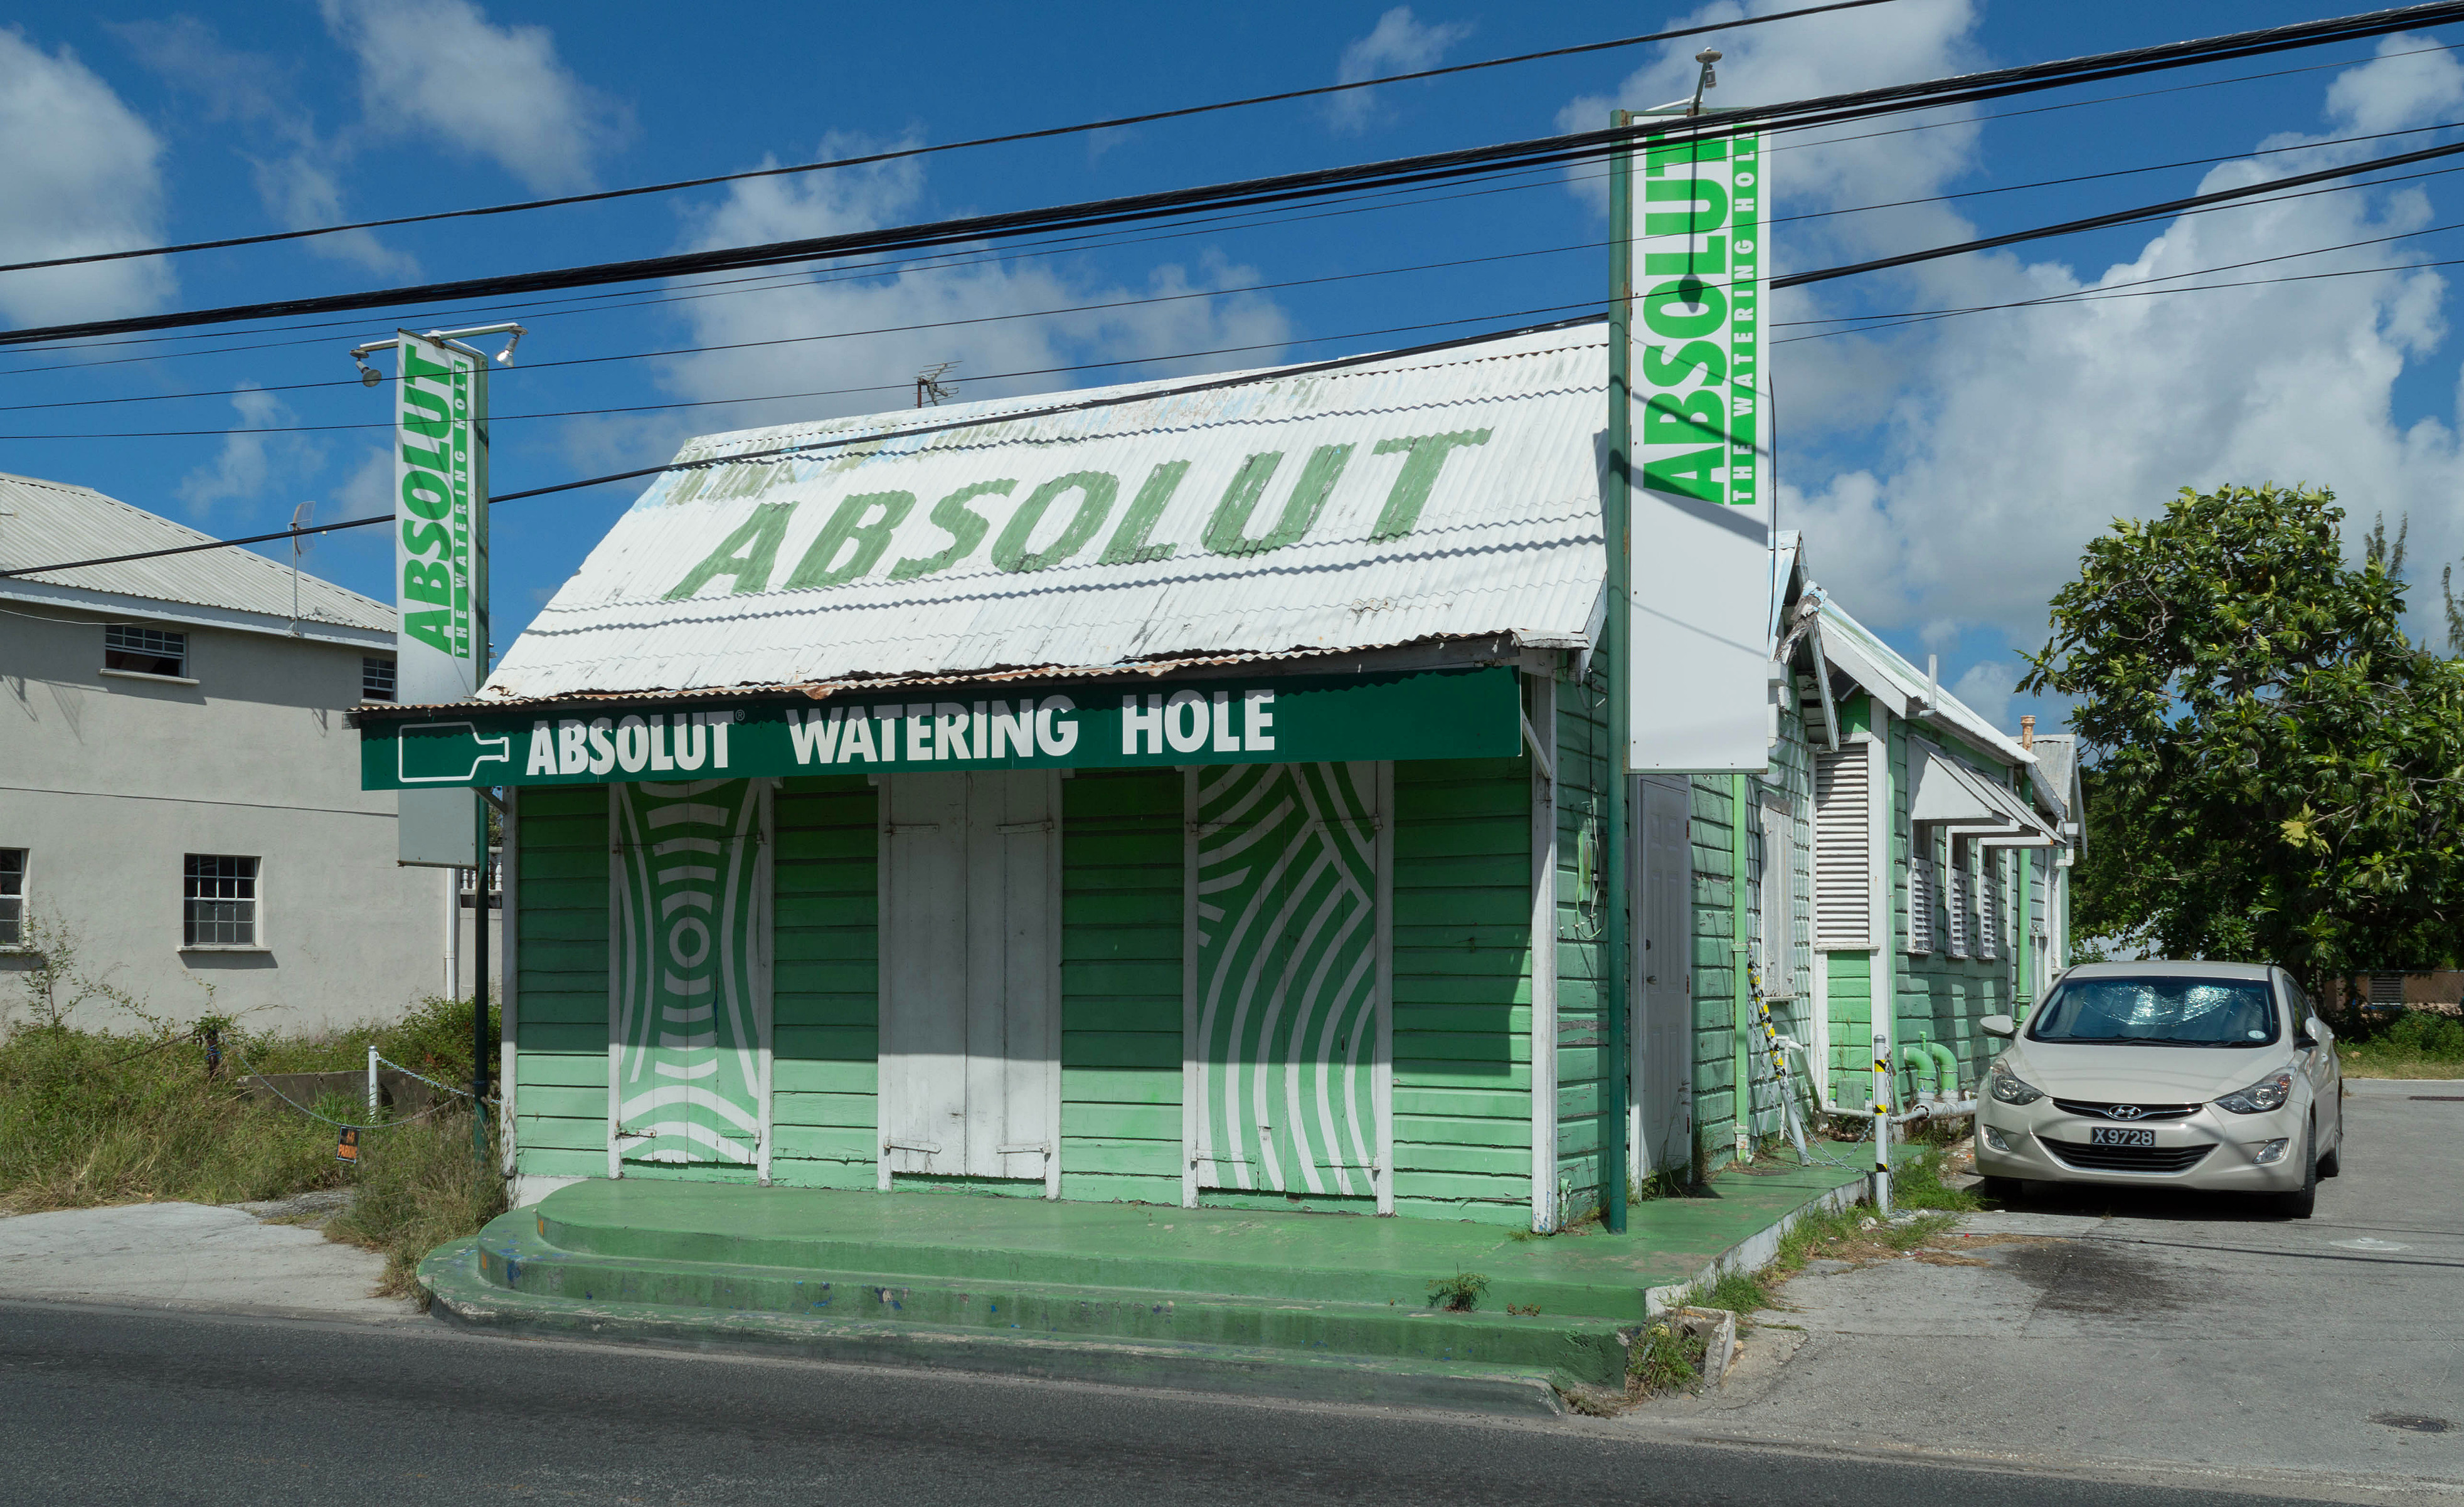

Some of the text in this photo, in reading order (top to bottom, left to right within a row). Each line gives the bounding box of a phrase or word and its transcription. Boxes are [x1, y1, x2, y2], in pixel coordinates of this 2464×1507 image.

[1643, 129, 1728, 505] ABSOLUT
[1733, 240, 1754, 417] WATERING
[402, 343, 452, 656] ABSOLUT
[455, 364, 468, 654] THE WATERING HOLE
[659, 426, 1495, 601] ABSOLUT
[1733, 444, 1753, 501] THE
[785, 695, 1079, 764] WATERING
[1122, 689, 1275, 754] HOLE
